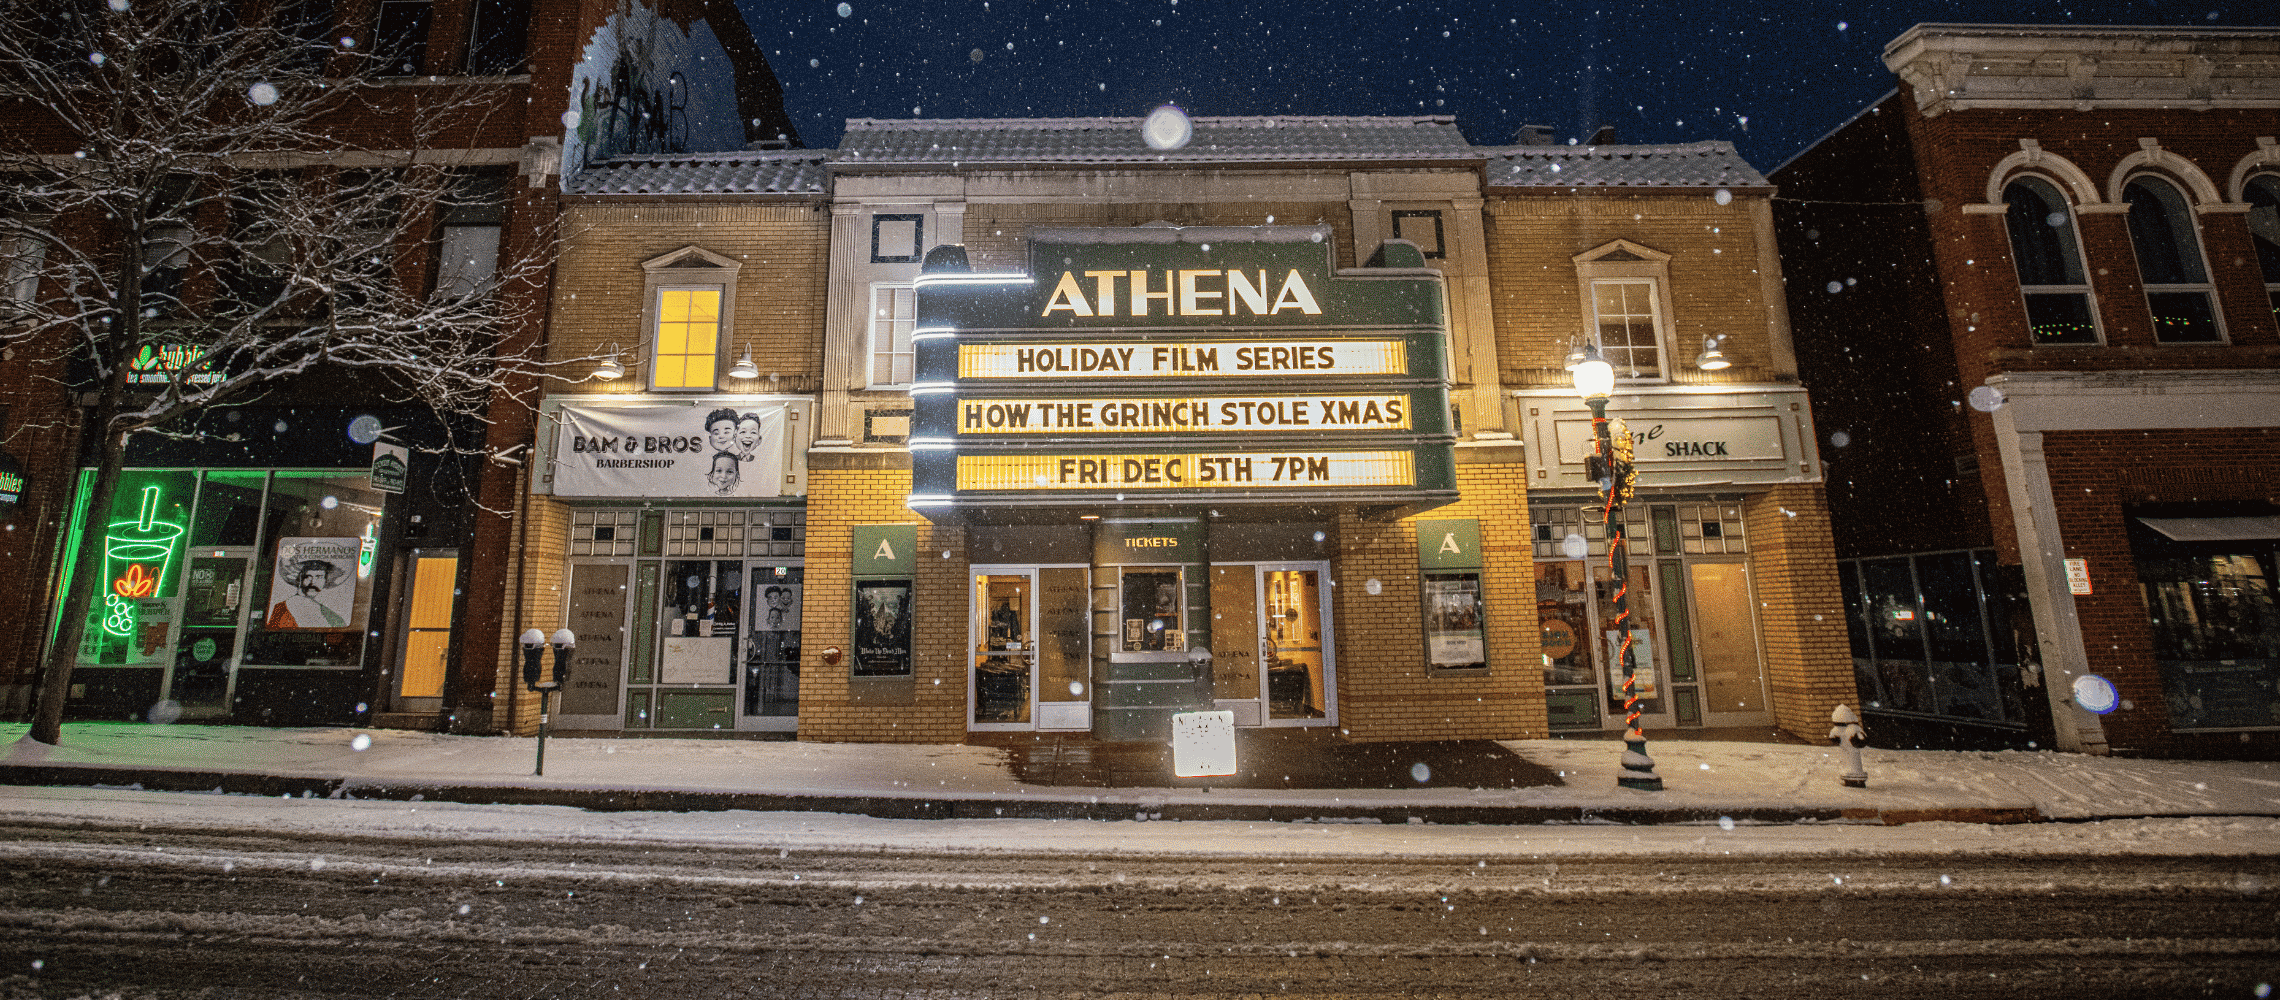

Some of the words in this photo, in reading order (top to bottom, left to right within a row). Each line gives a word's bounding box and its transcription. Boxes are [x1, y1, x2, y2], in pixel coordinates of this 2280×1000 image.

[1041, 268, 1322, 317] ATHENA
[1017, 347, 1133, 372] HOLIDAY
[1153, 346, 1218, 371] FILM
[1236, 346, 1335, 370] SERIES
[964, 404, 1030, 428] HOW
[1038, 403, 1092, 427] THE
[1101, 402, 1210, 427] GRINCH
[1222, 401, 1309, 426] STOLE
[1321, 400, 1402, 425] XMAS
[573, 436, 619, 453] BAM
[624, 436, 639, 453] &
[644, 435, 703, 453] BROS
[1665, 441, 1729, 457] SHACK
[596, 459, 675, 468] BARBERSHOP
[1059, 459, 1108, 484] FRI
[1124, 459, 1182, 483] DEC
[1200, 457, 1252, 482] 5TH
[1271, 457, 1330, 481] 7PM
[873, 539, 896, 559] A
[1124, 537, 1178, 547] TICKETS
[1439, 533, 1461, 554] A
[582, 587, 616, 595] ATHENA
[580, 610, 614, 618] ATHENA
[577, 634, 612, 642] ATHENA
[573, 681, 609, 689] ATHENA
